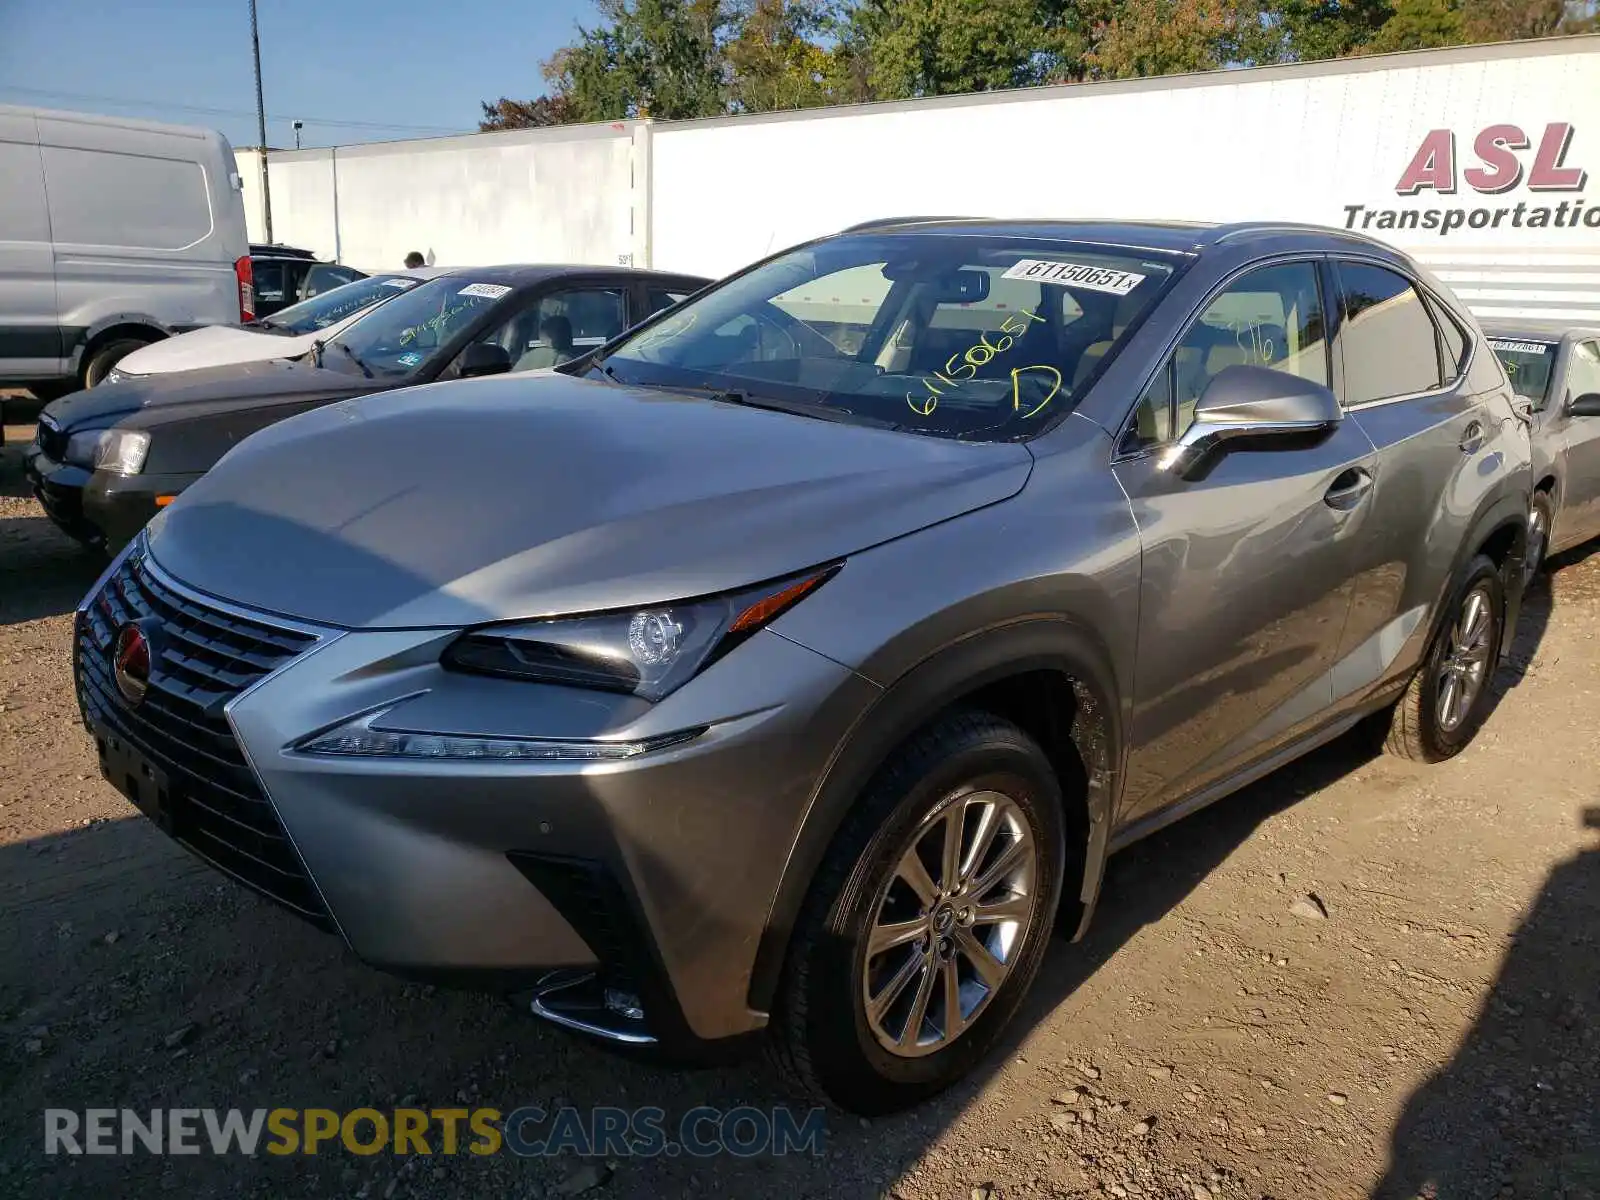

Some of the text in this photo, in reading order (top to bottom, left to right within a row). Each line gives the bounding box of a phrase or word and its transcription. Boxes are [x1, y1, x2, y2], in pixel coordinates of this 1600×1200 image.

[1394, 122, 1589, 196] ASL
[906, 309, 1047, 416] 61150651
[1010, 365, 1062, 419] D
